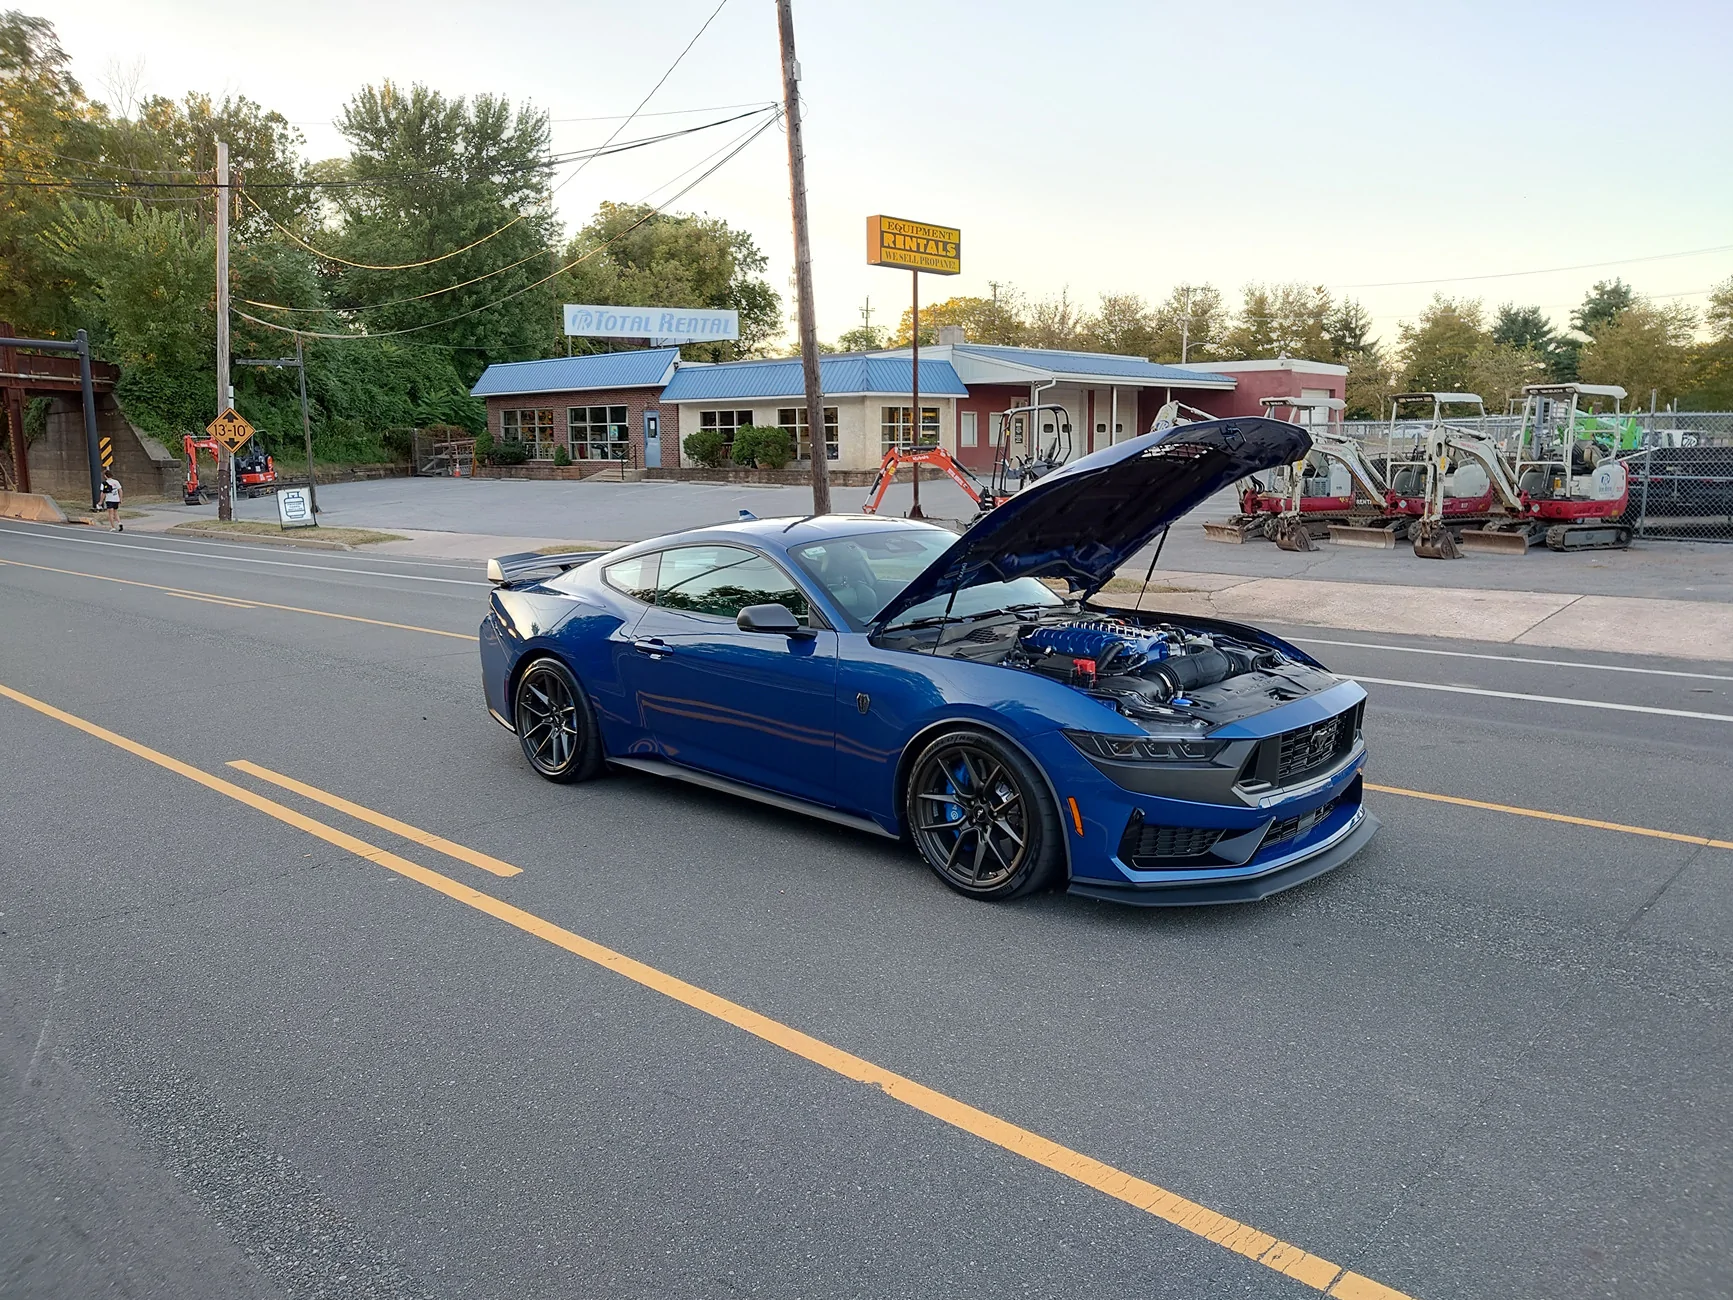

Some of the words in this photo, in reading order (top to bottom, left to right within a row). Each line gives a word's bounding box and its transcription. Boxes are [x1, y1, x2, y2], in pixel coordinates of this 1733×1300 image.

[887, 221, 953, 240] EQUIPMENT
[883, 232, 957, 257] RENTALS
[885, 250, 898, 261] WE
[899, 253, 919, 265] SELL
[594, 310, 652, 332] TOTAL
[658, 312, 732, 334] RENTAL
